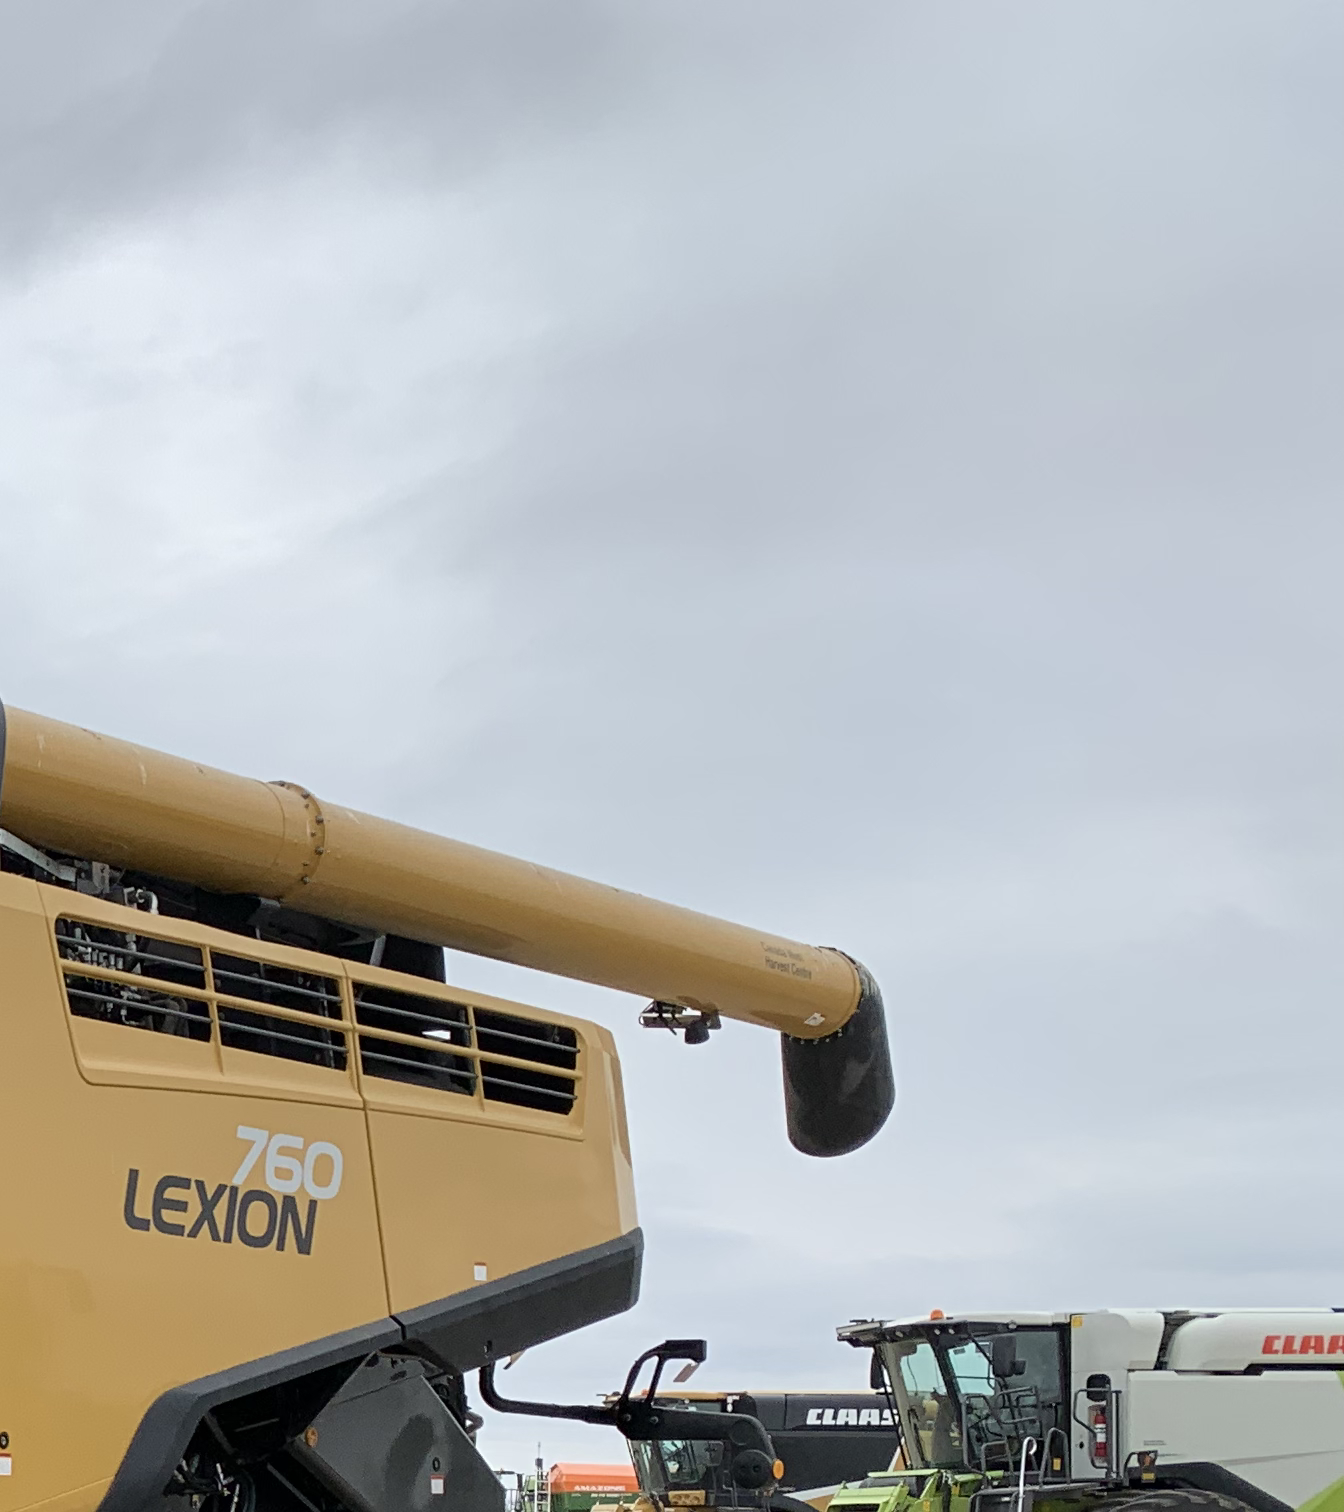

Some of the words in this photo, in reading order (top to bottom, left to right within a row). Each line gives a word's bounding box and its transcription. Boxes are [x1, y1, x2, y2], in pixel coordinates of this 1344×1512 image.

[231, 1125, 343, 1200] 760
[123, 1168, 318, 1256] LEXION
[805, 1408, 900, 1426] CLAAS
